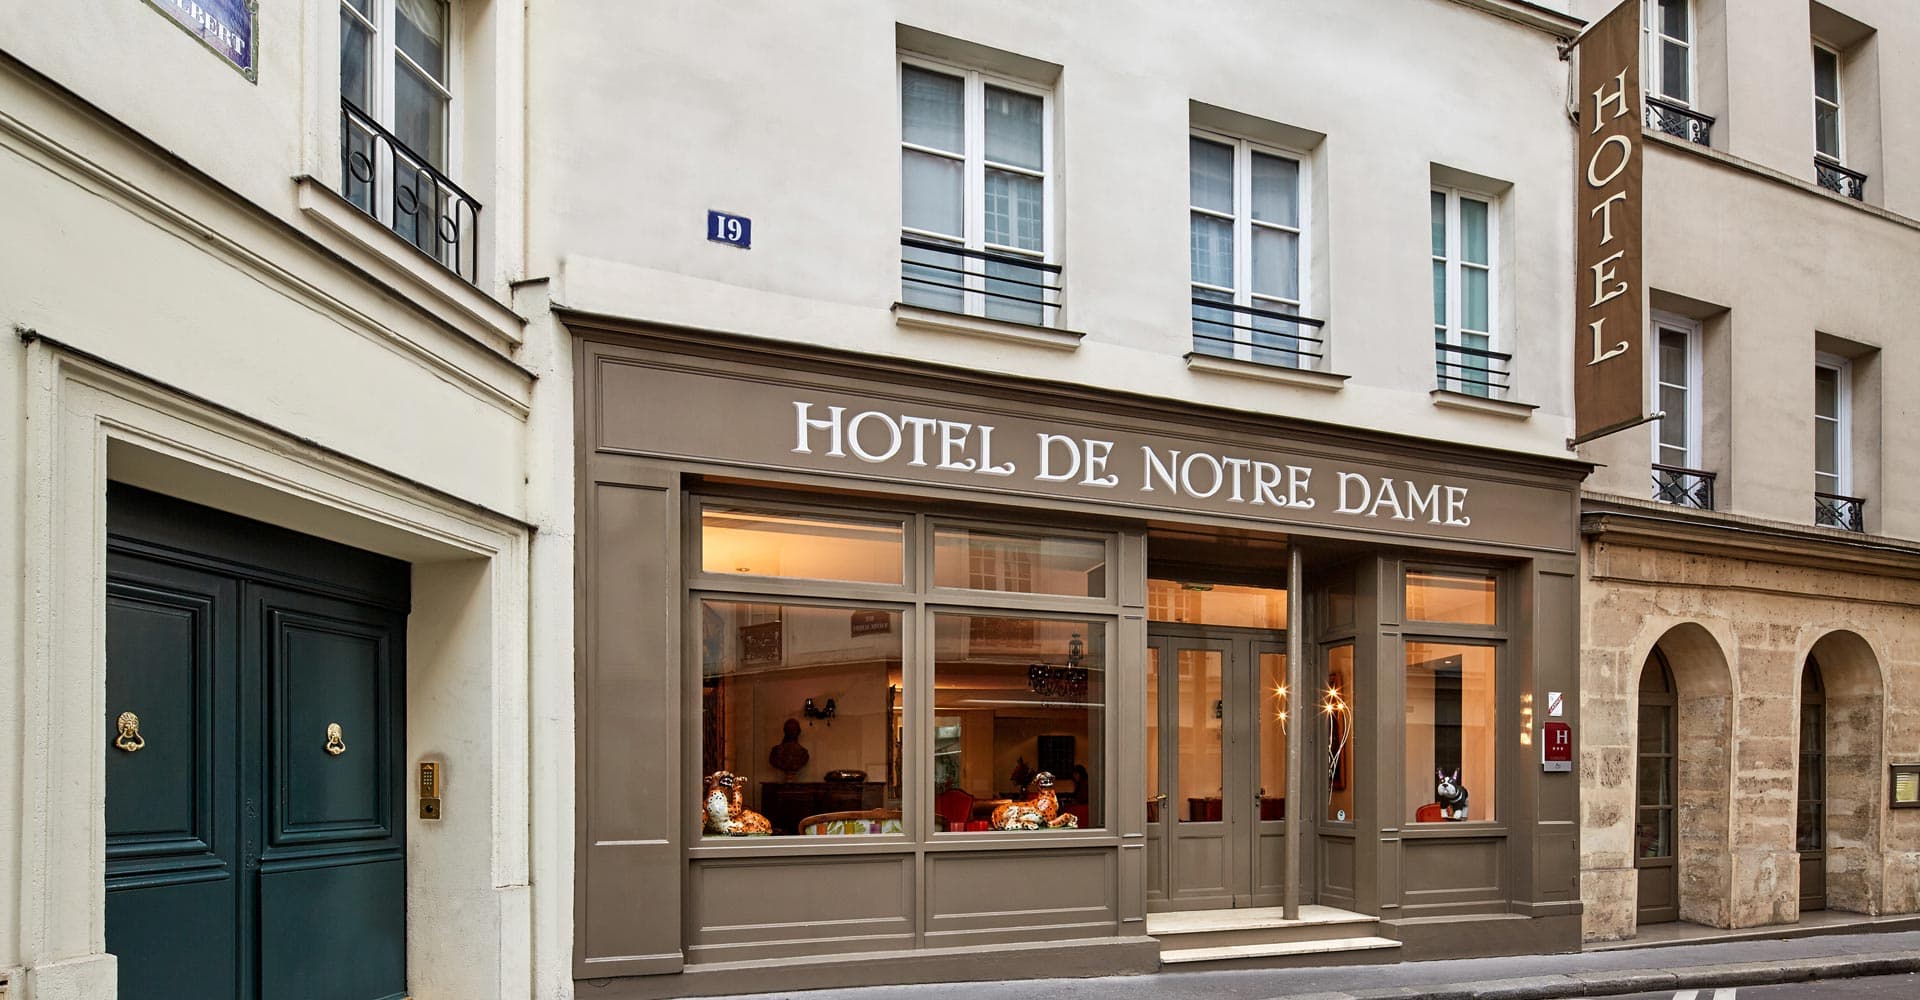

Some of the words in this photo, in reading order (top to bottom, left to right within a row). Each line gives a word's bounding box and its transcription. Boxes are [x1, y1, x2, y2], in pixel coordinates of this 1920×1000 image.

[717, 215, 742, 241] 19
[1586, 65, 1632, 367] HOTEL
[791, 401, 1016, 477] HOTEL
[1034, 433, 1119, 488] DE
[1140, 445, 1316, 510] NOTRE
[1333, 471, 1471, 527] DAME
[1556, 729, 1568, 744] H
